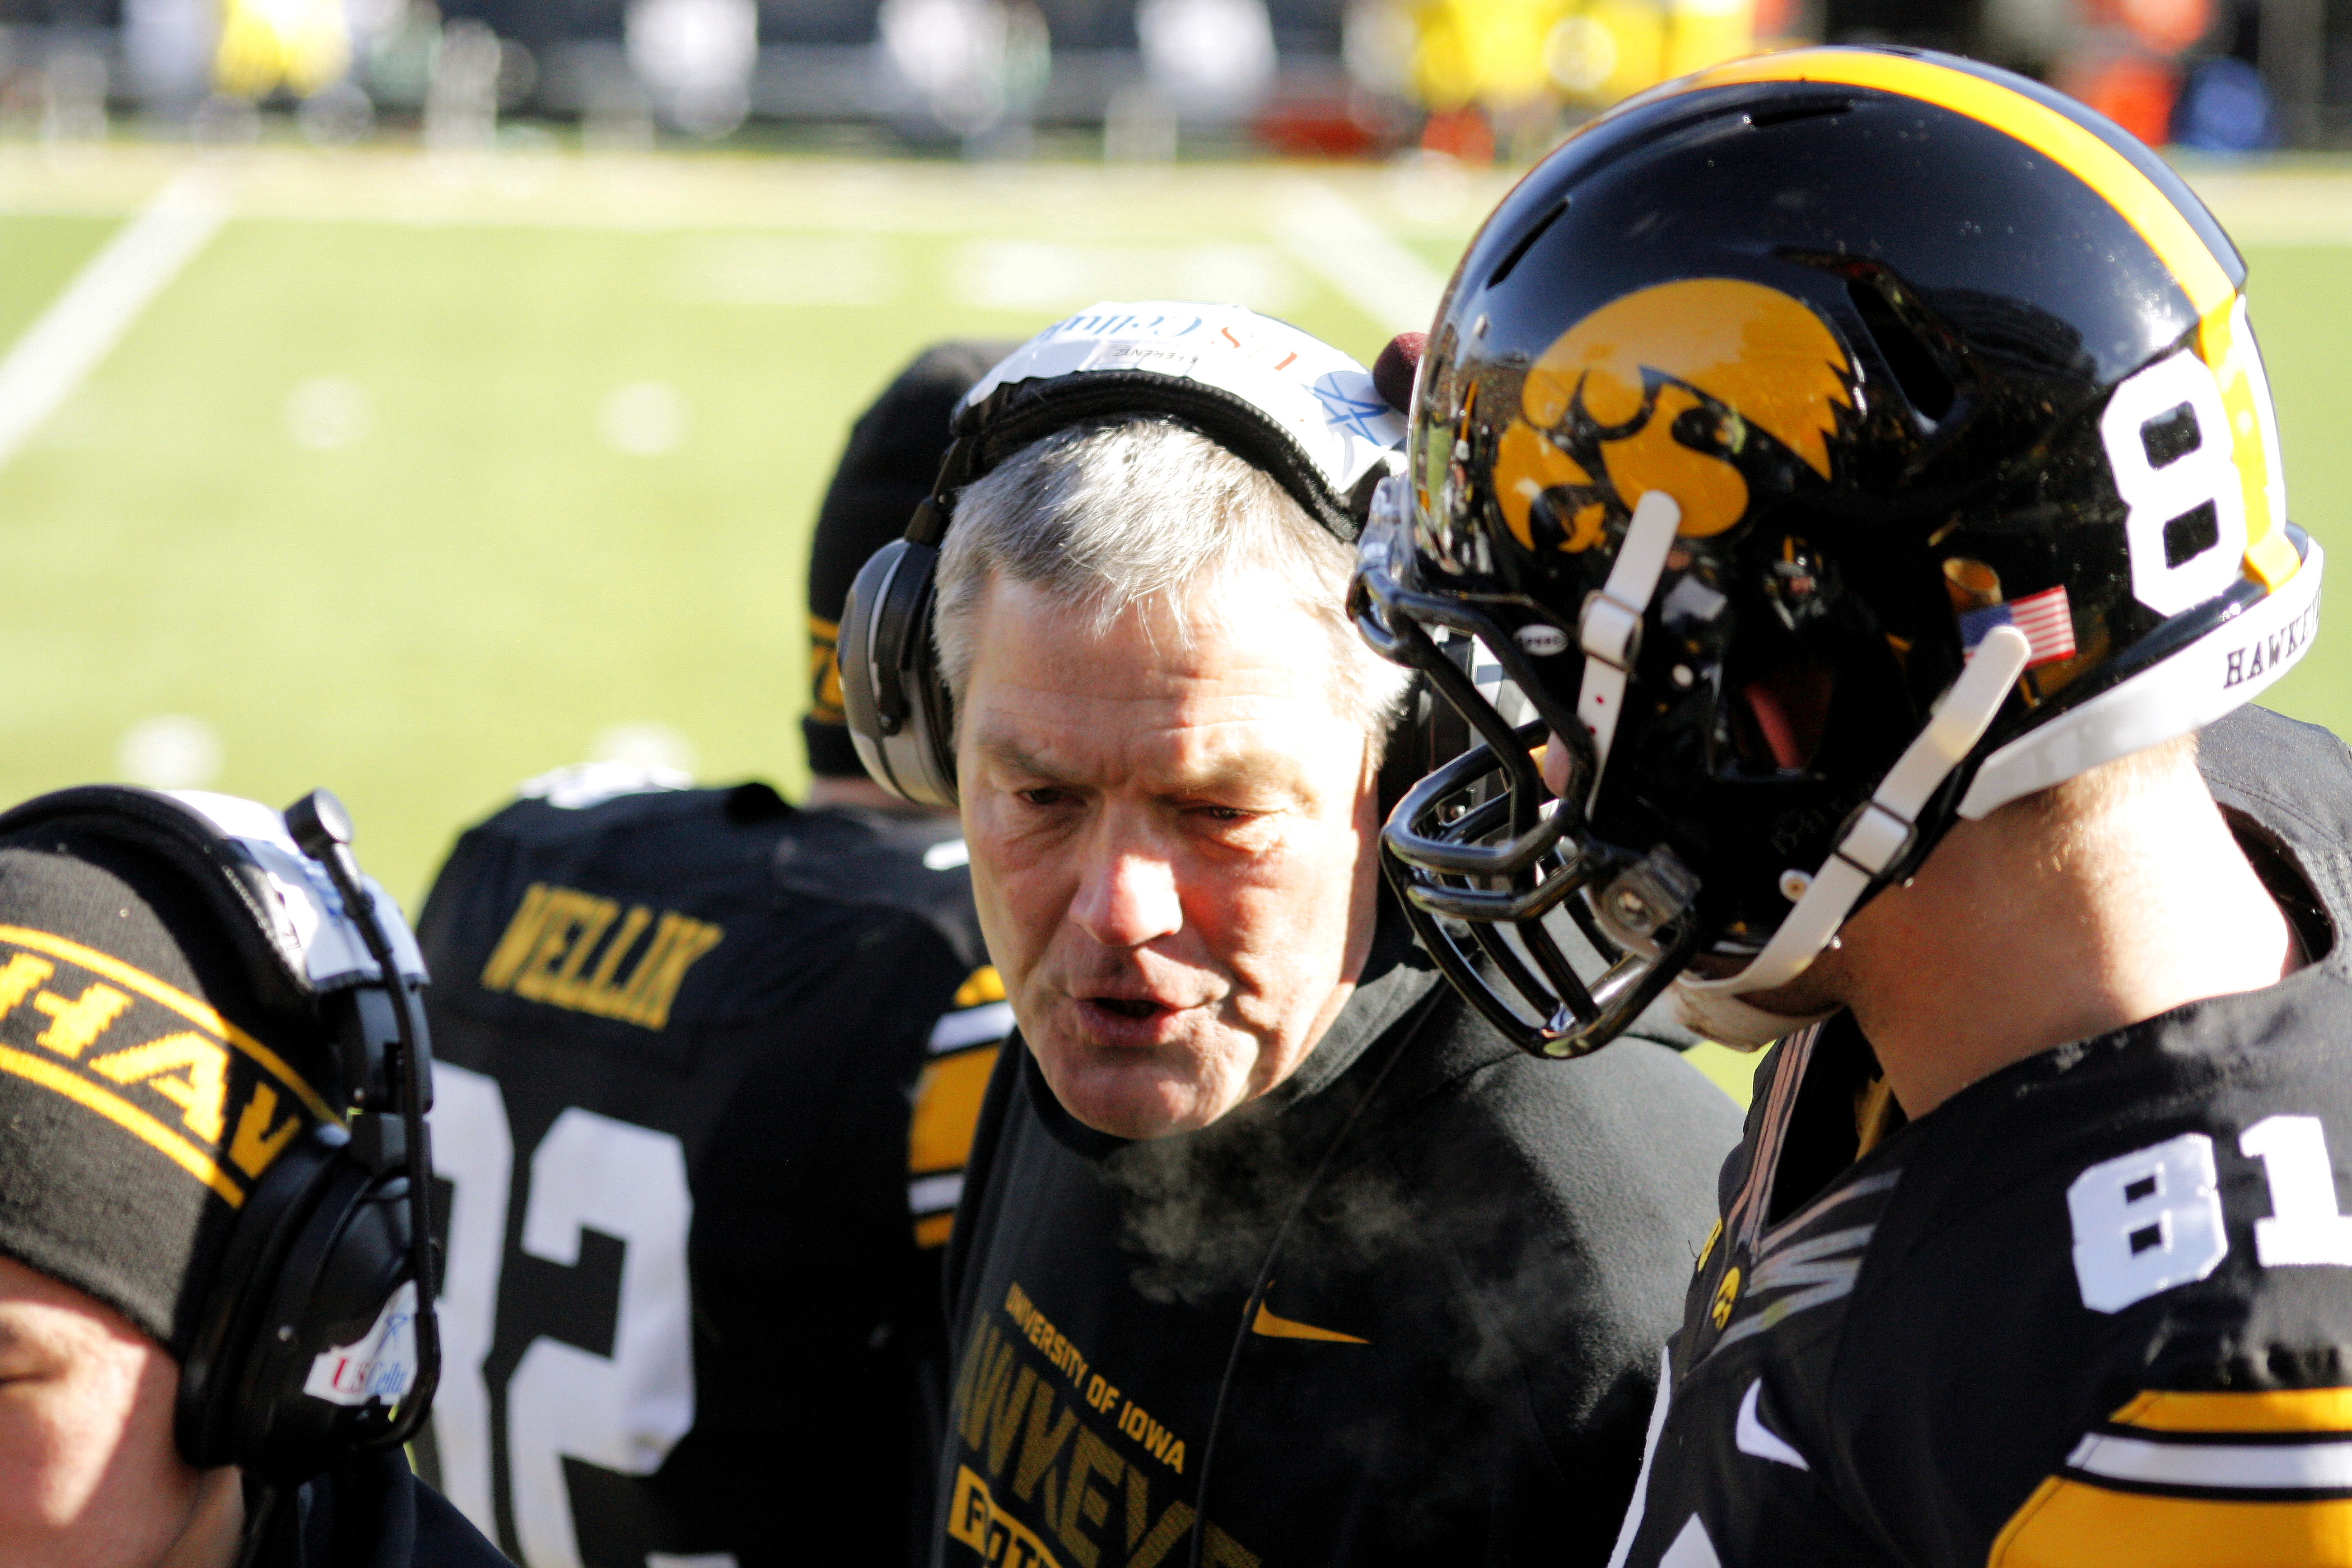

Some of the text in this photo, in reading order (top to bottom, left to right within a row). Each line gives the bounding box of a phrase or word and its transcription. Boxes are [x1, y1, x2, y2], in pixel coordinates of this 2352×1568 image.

[2099, 348, 2248, 618] 8
[2066, 1114, 2352, 1315] 81
[1085, 1374, 1121, 1415] OF
[1117, 1400, 1186, 1474] IOWA
